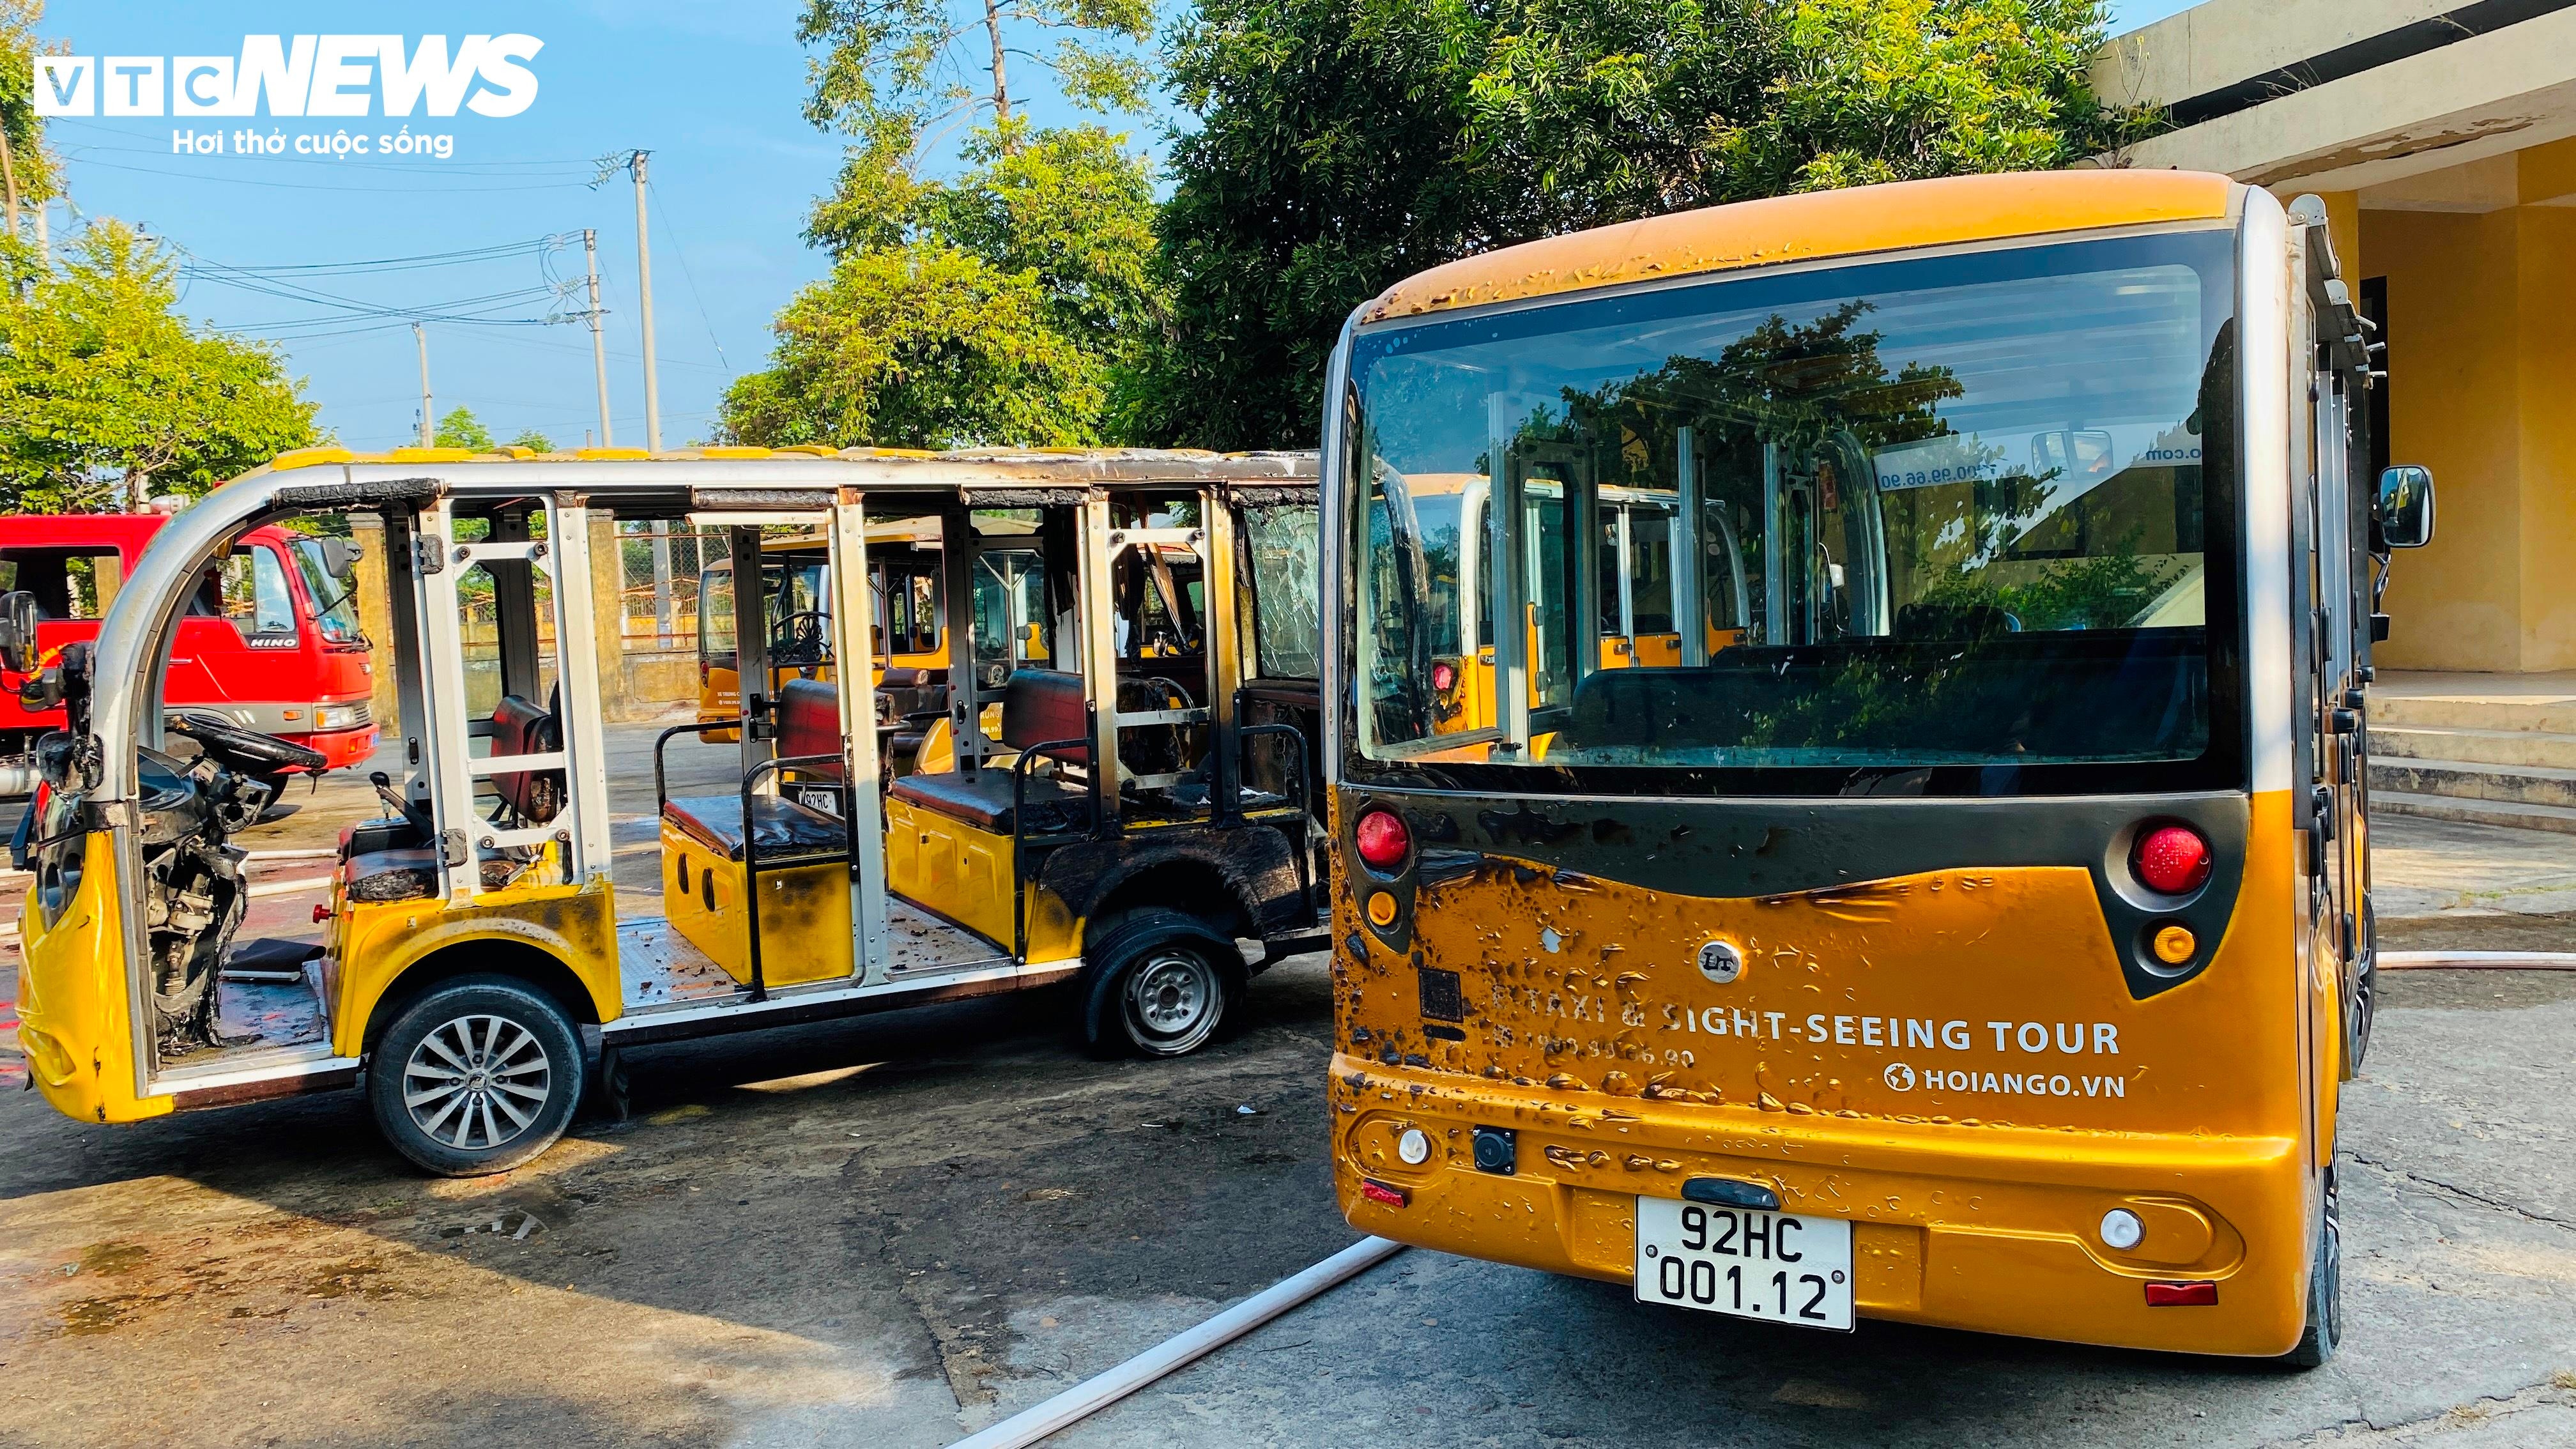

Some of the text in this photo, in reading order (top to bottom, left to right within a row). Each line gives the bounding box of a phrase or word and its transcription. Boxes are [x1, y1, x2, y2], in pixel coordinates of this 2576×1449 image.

[981, 711, 1000, 719] RUNG
[806, 793, 828, 809] 92HC
[1621, 1001, 1646, 1027] &
[1659, 1003, 1970, 1051] SIGHT-SEEING
[1987, 1021, 2120, 1055] TOUR
[1924, 1069, 2126, 1098] HOIANGO.VN
[1682, 1206, 1803, 1262] 92HC
[1660, 1256, 1827, 1321] 001.12
